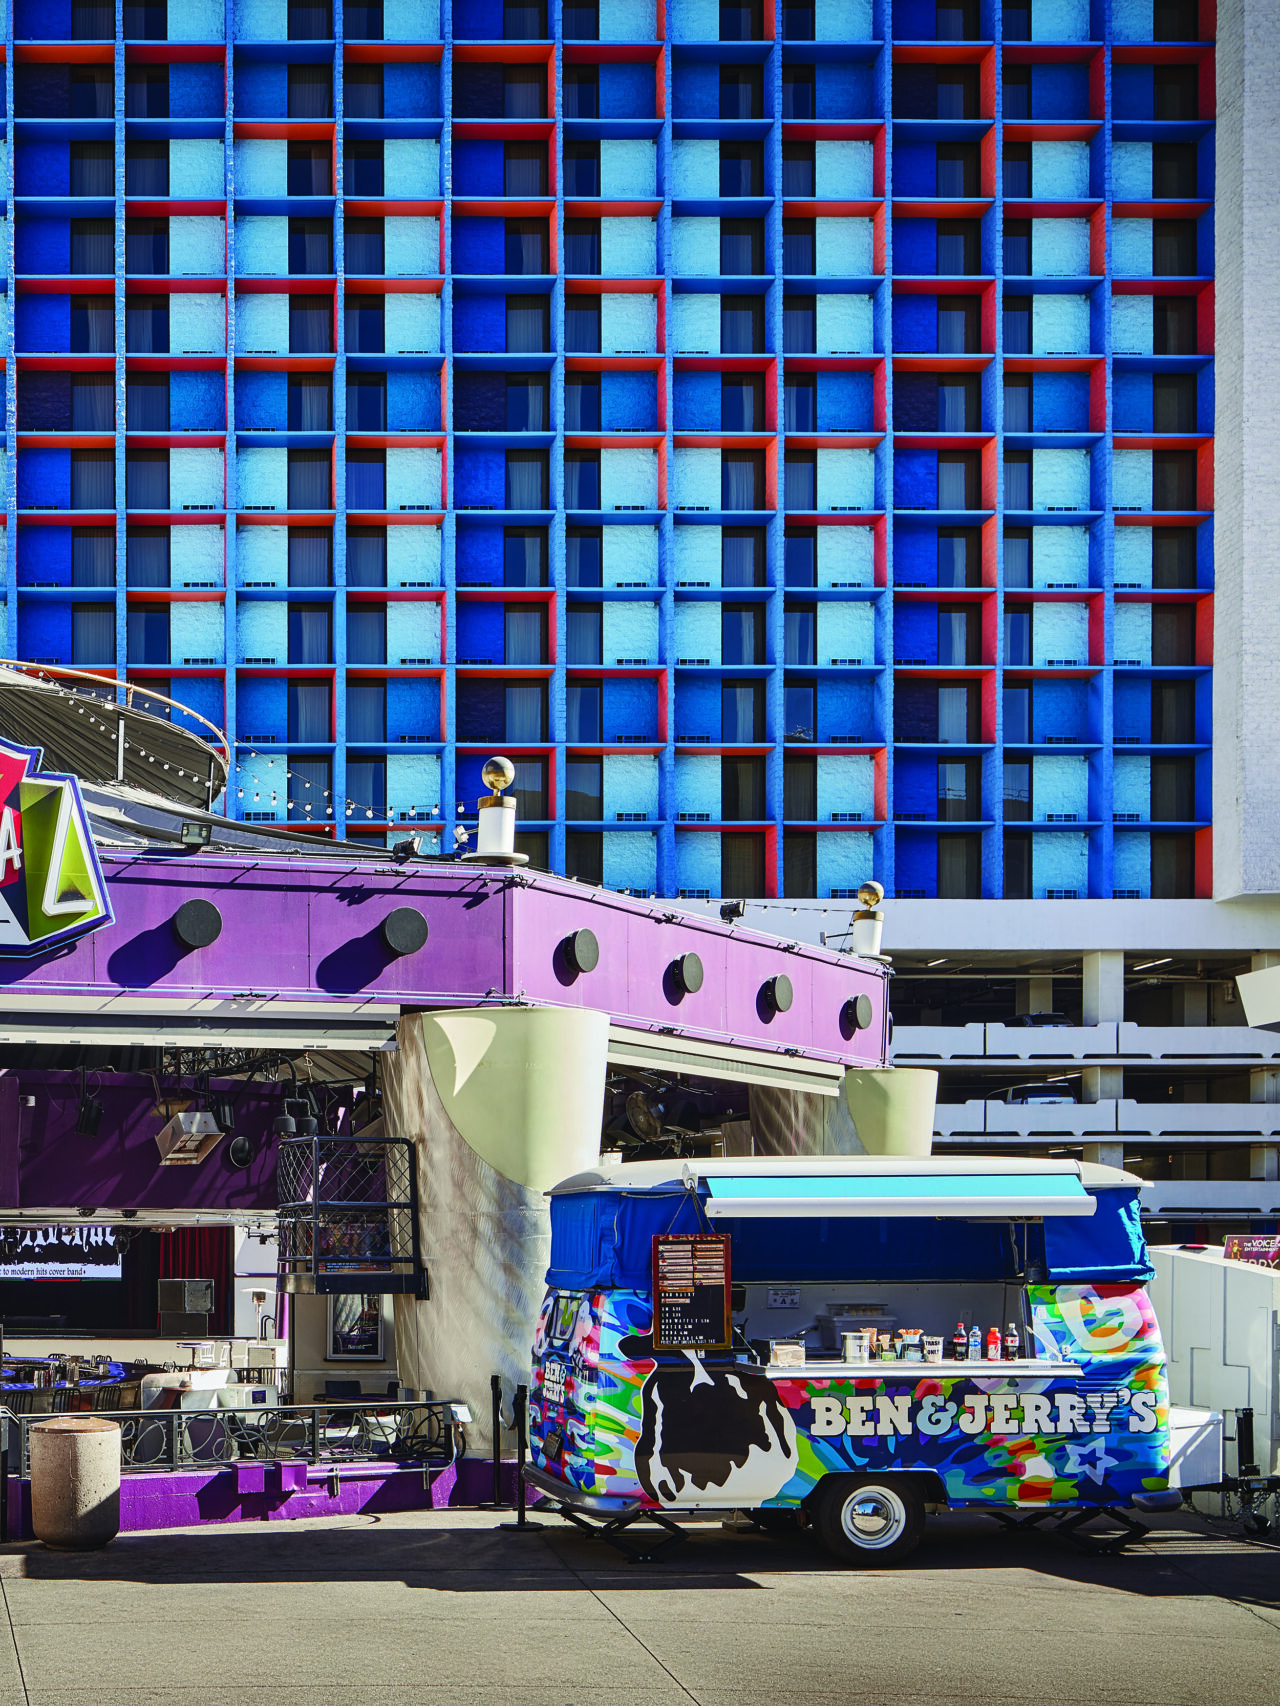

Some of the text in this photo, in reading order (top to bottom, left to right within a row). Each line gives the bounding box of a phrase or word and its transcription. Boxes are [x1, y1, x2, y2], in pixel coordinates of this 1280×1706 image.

[11, 1267, 34, 1275] modern
[36, 1267, 47, 1275] hits
[67, 1267, 82, 1275] band
[810, 1387, 1159, 1436] BEN & JERRY'S
